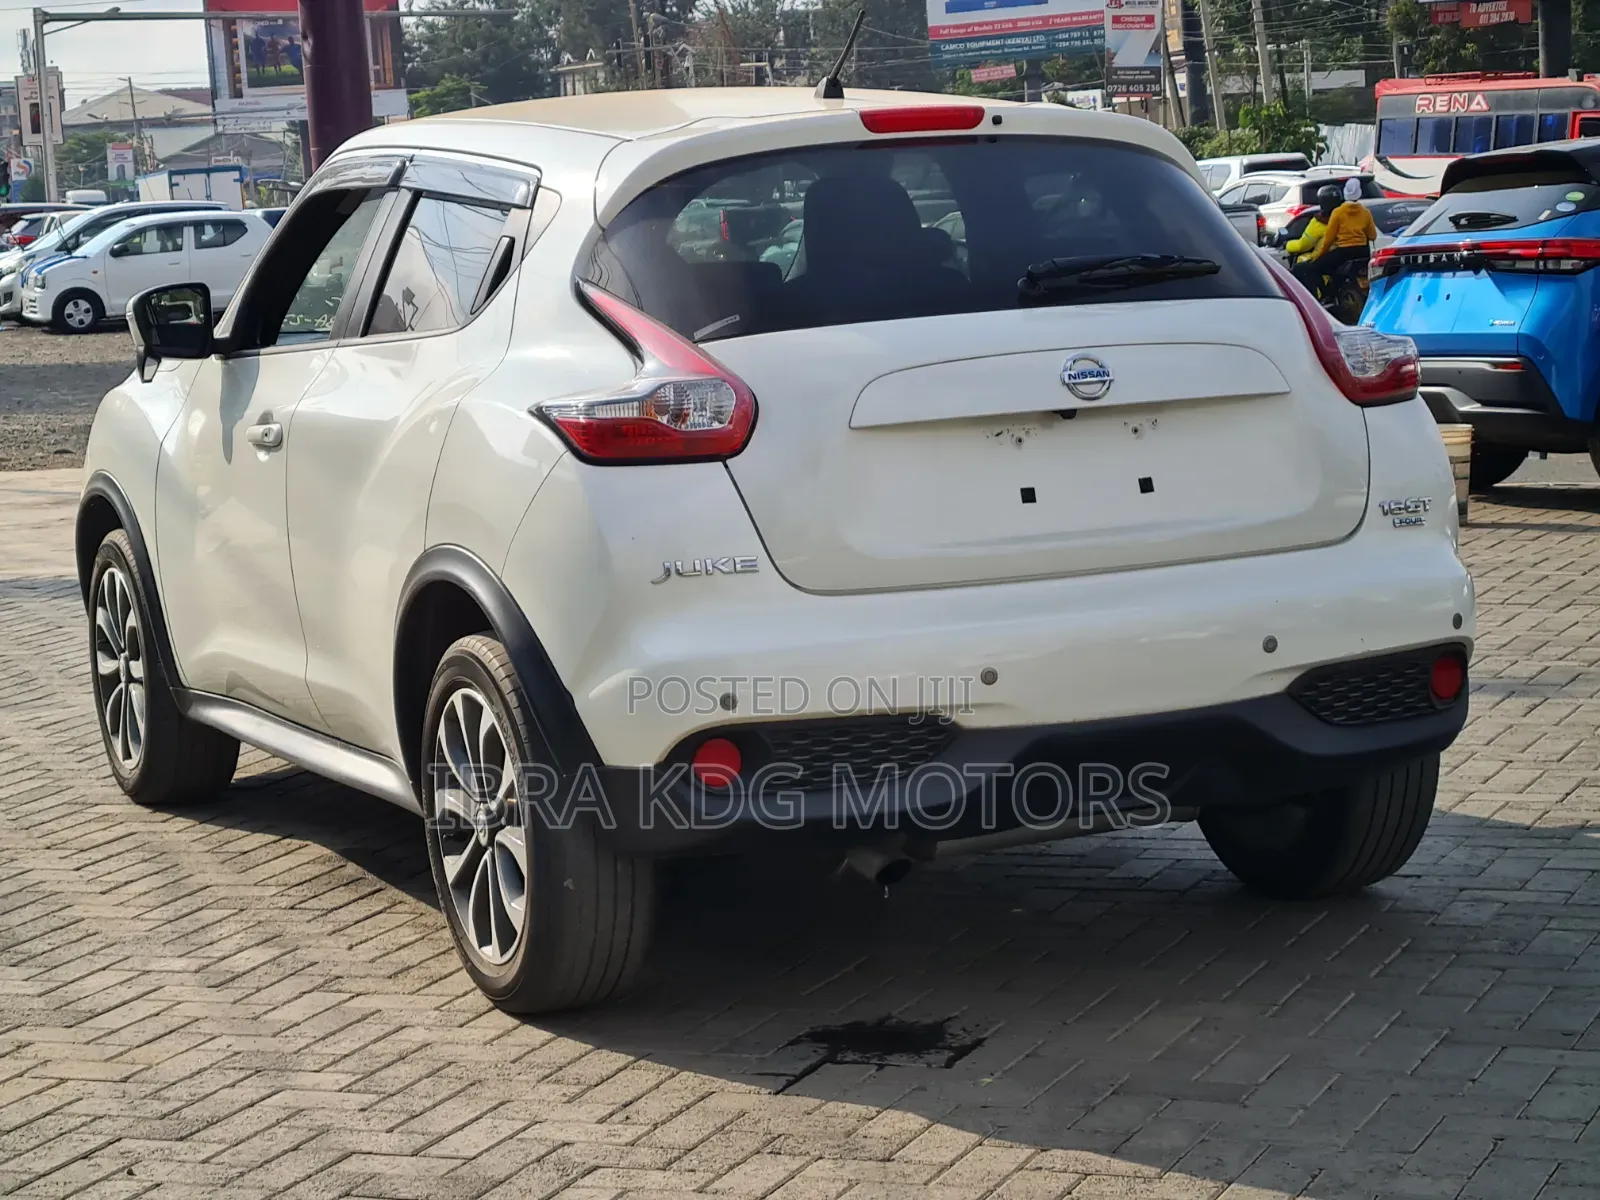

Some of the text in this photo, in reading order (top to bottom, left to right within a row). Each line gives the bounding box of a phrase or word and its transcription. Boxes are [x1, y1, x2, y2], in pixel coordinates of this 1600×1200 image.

[1477, 1, 1509, 12] ADVERTISE
[1416, 92, 1490, 113] RENA
[1400, 253, 1460, 265] NISSAN
[1068, 370, 1110, 381] NISSAN
[650, 555, 759, 584] JUKE
